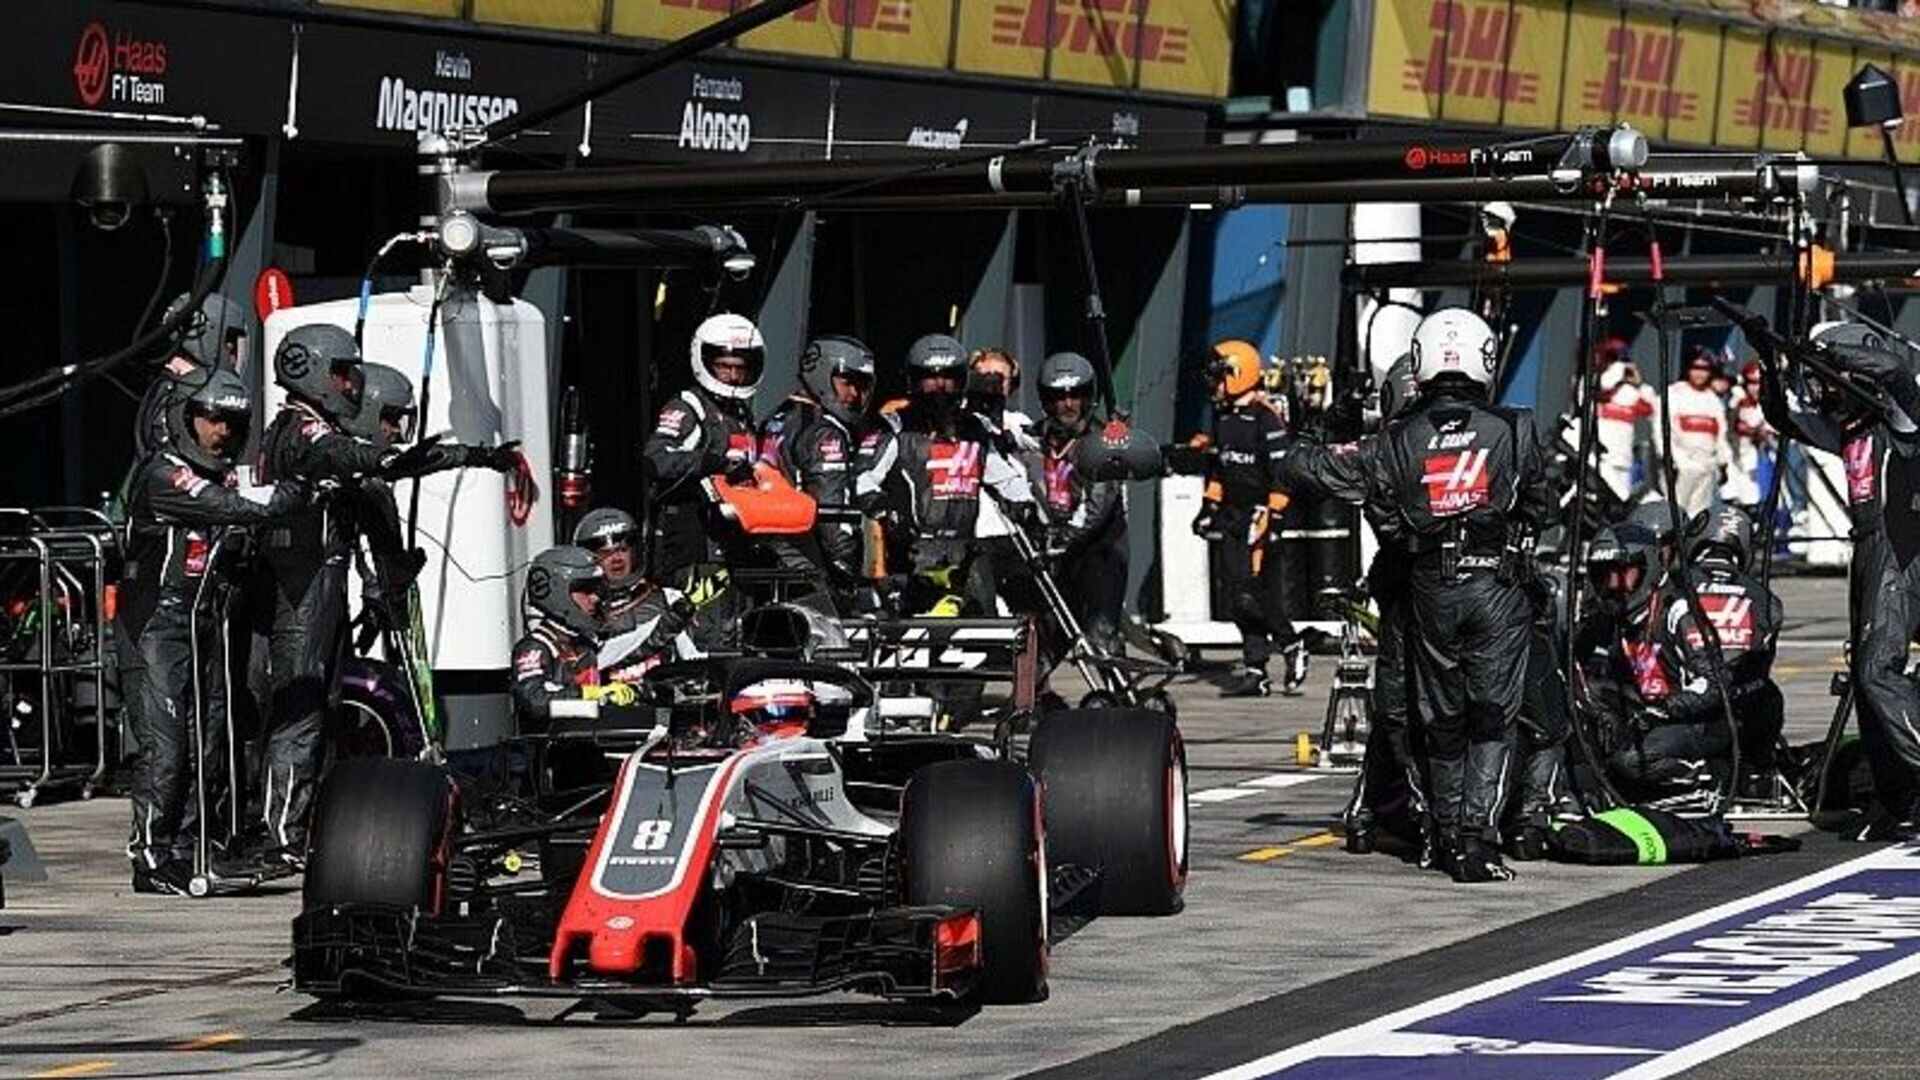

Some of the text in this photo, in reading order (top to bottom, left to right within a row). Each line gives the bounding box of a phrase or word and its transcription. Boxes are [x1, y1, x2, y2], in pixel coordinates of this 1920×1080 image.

[114, 32, 167, 73] Haas
[435, 50, 472, 80] Kevin
[111, 74, 164, 104] F1 Team
[376, 76, 519, 141] Magnussen
[678, 101, 750, 152] Alonso
[631, 819, 673, 851] 8
